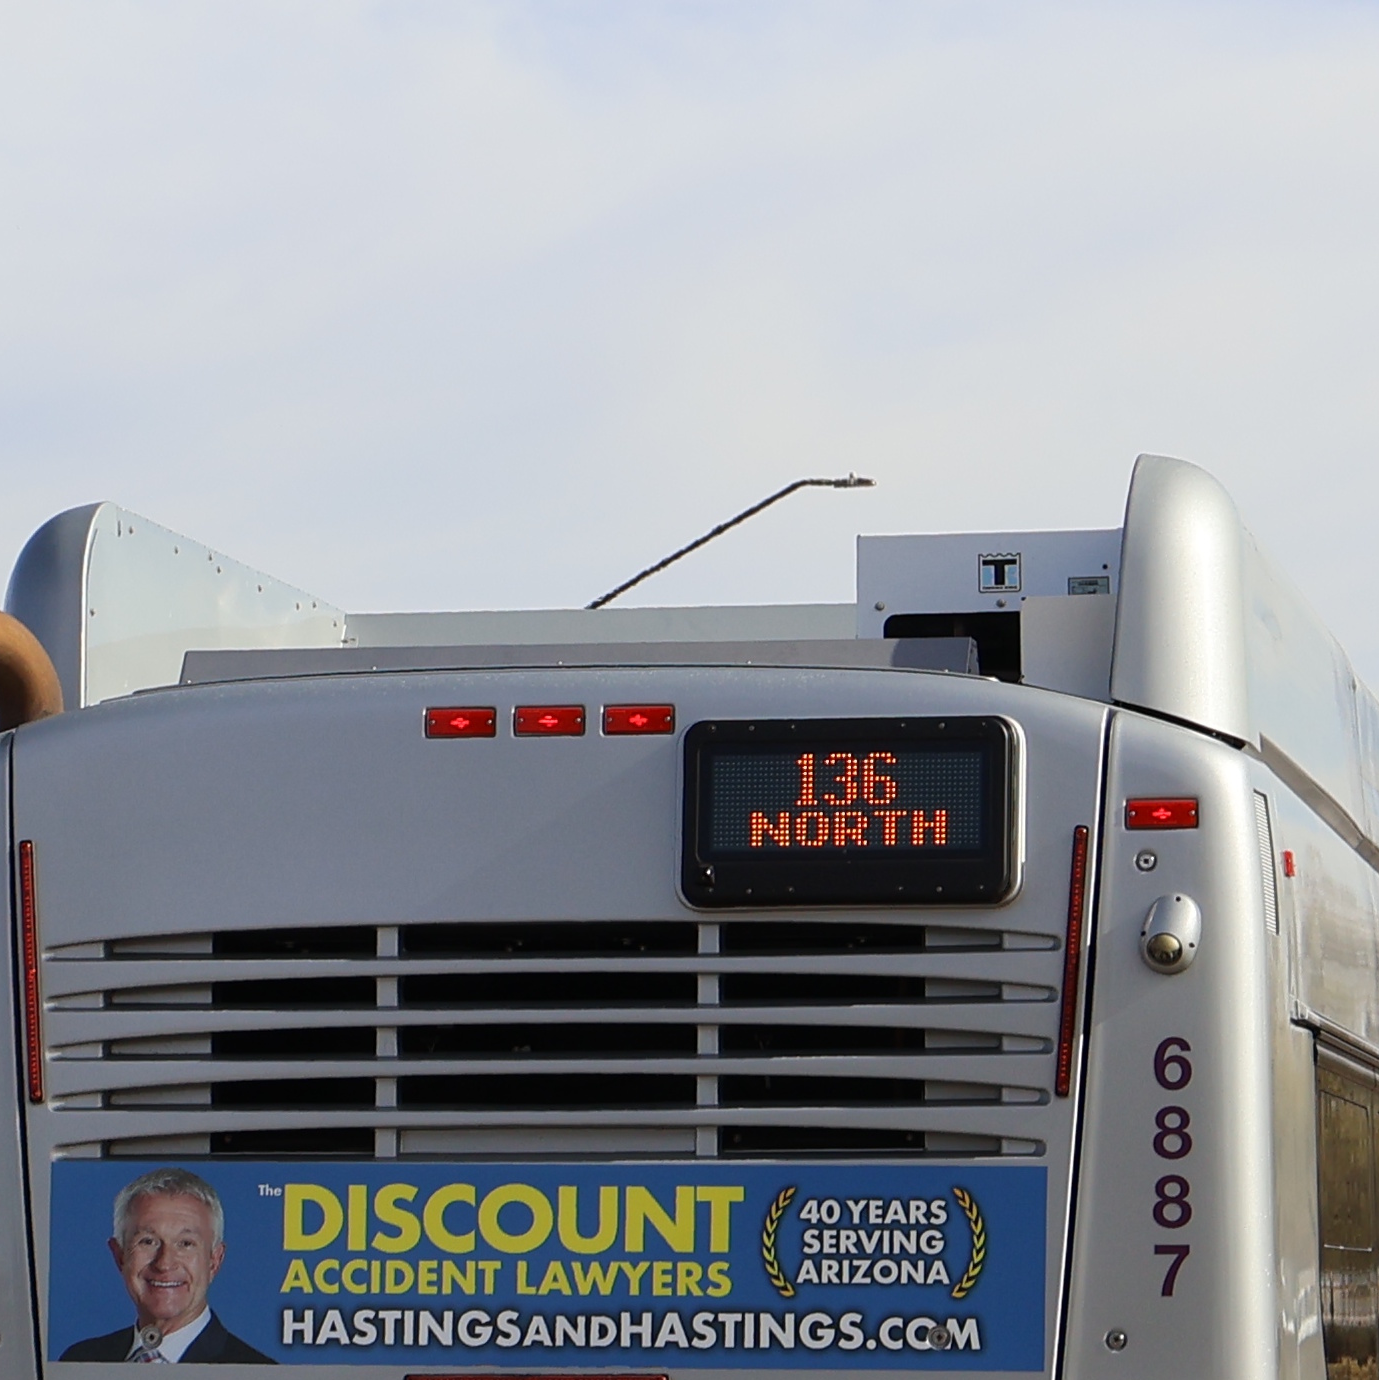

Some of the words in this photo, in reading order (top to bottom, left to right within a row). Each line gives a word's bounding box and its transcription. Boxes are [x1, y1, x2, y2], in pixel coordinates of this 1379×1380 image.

[794, 752, 897, 806] 136
[749, 809, 949, 847] NORTH
[1153, 1036, 1193, 1297] 6887
[258, 1184, 282, 1197] The
[283, 1183, 745, 1254] DISCOUNT
[799, 1199, 842, 1224] 40
[846, 1199, 948, 1225] YEARS
[802, 1229, 945, 1255] SERVING
[279, 1259, 502, 1295] ACCIDENT
[516, 1261, 733, 1298] LAWYERS
[796, 1259, 950, 1285] ARIZONA
[281, 1308, 982, 1351] HASTINGSANDHASTINGS.COM
